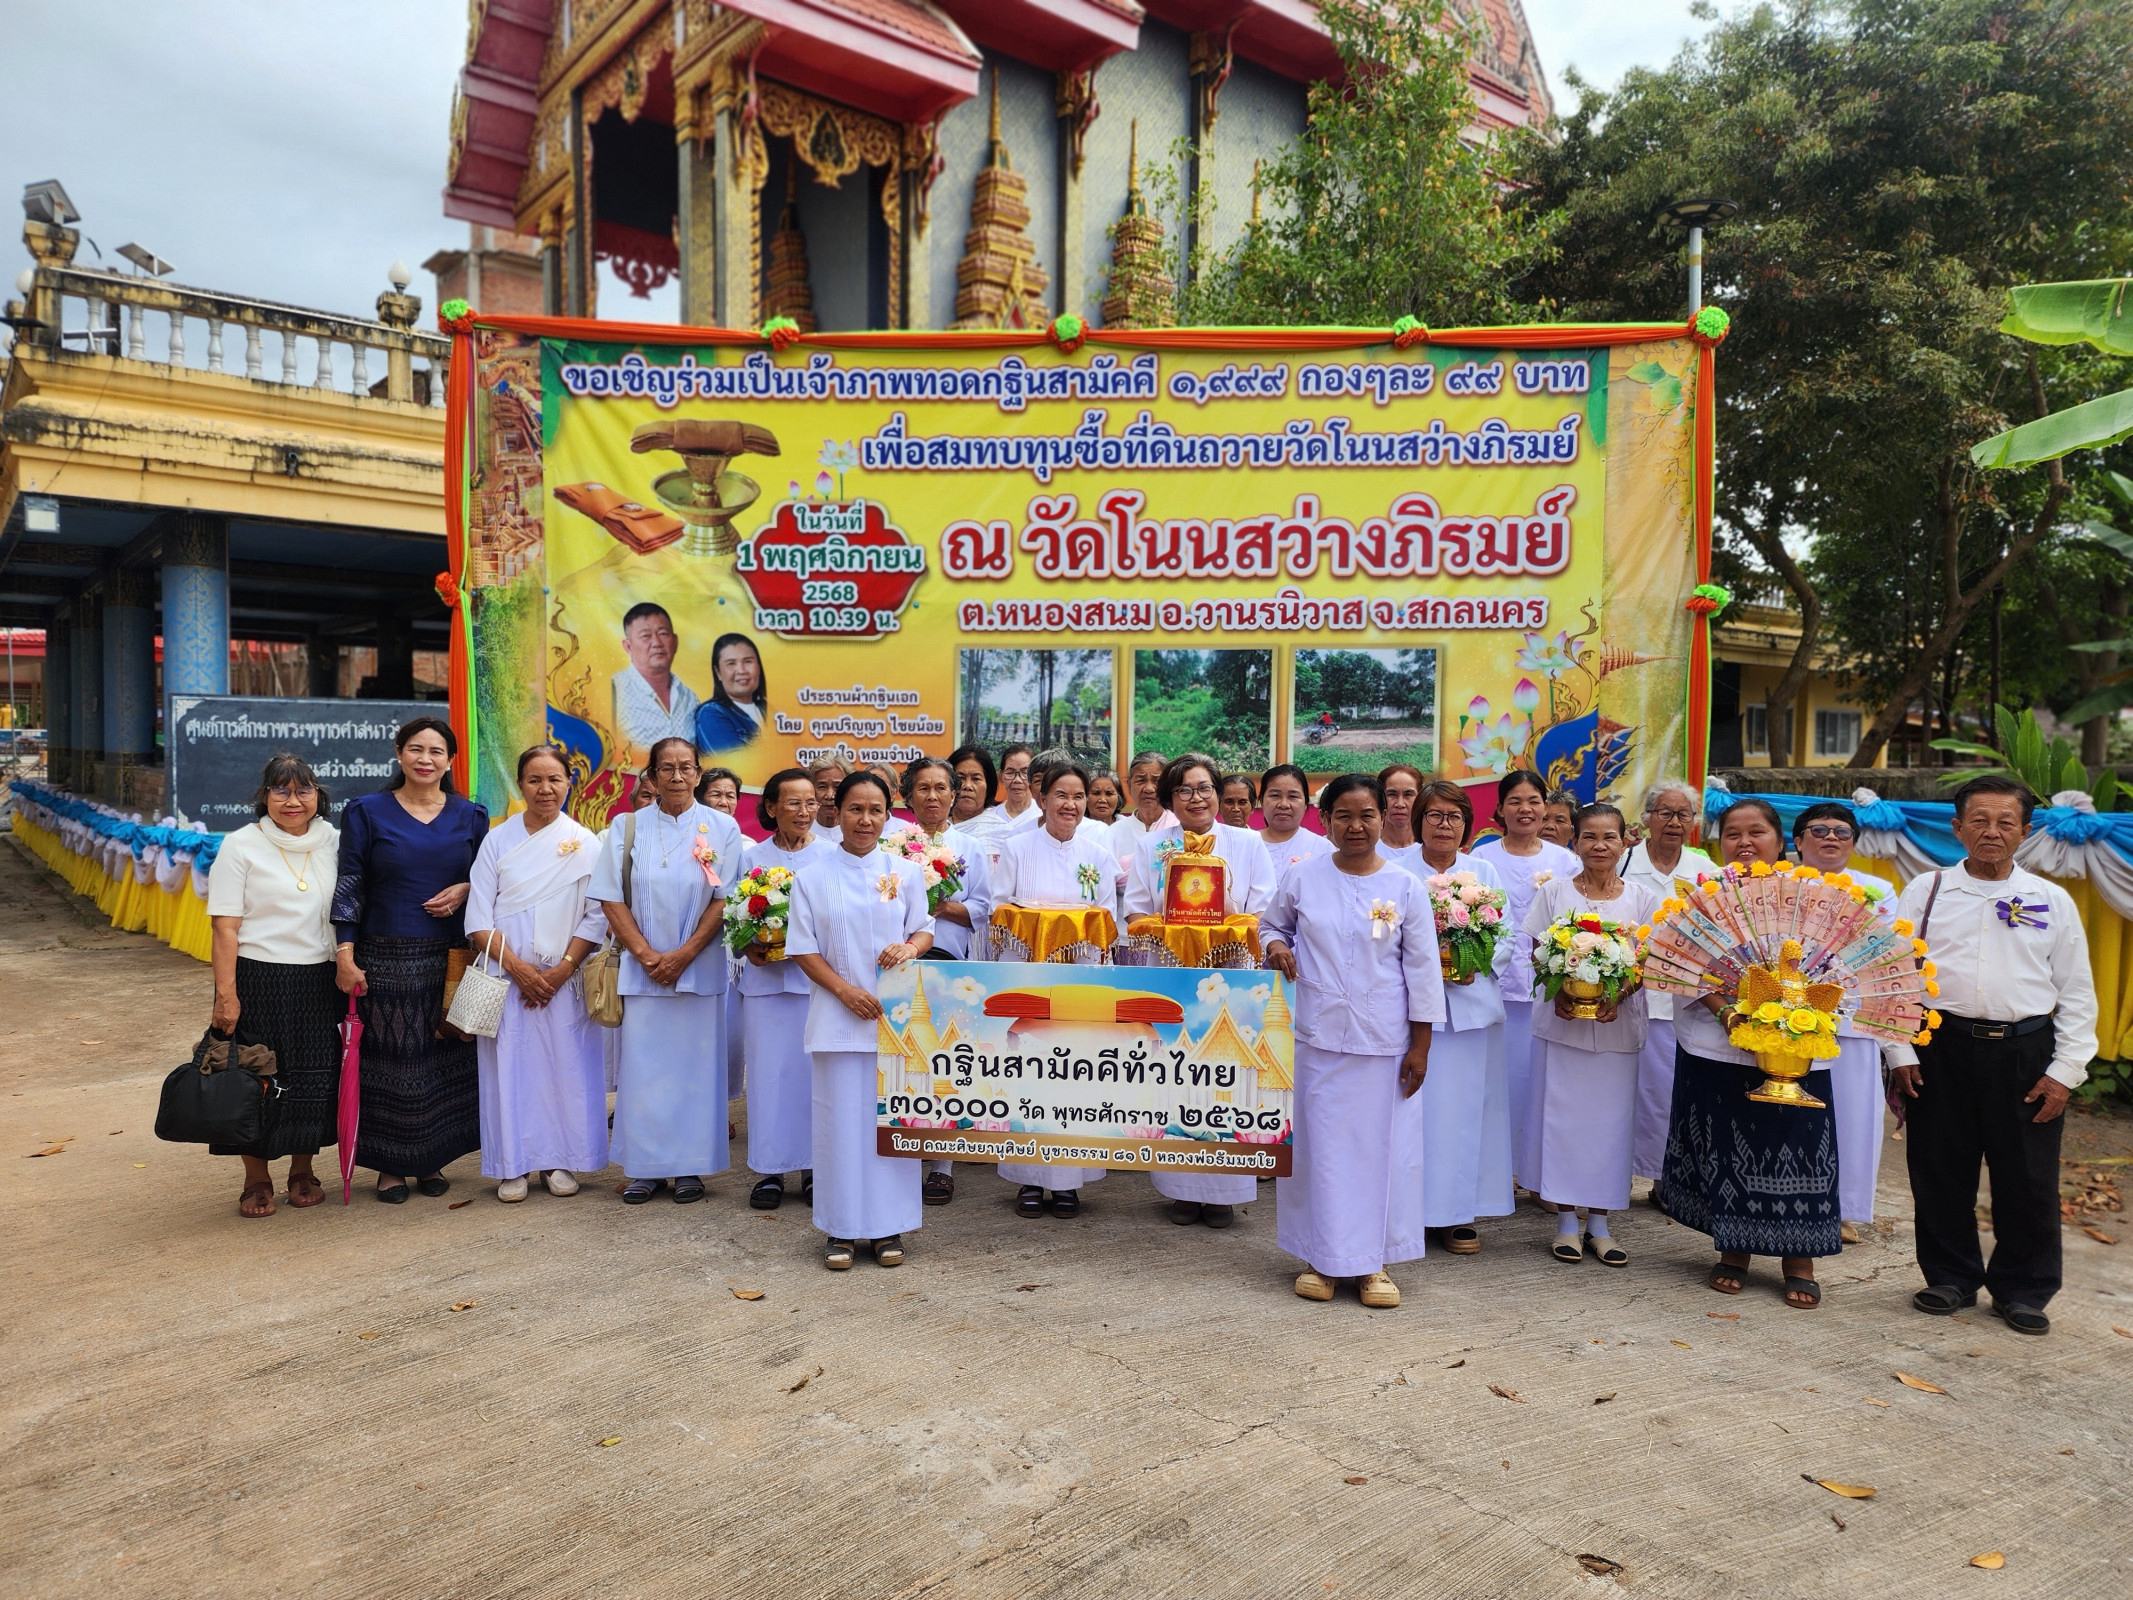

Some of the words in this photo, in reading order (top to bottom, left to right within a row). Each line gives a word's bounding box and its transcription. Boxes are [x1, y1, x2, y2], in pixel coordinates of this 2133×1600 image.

[565, 354, 1155, 406] ขอเชิญร่วมเป็นเจ้าภาพทอดกฐินสามัคคี
[1173, 365, 1285, 398] ๑,๙๙๙
[1302, 365, 1431, 402] กองๆละ
[1449, 364, 1501, 393] ๙๙
[1517, 362, 1586, 391] บาท
[865, 414, 1577, 478] เพื่อสมทบทุนซื้อที่ดินถวายวัดโนนสว่างภิรมย์
[796, 504, 863, 532] ในวันที่
[947, 526, 1005, 571] ณ
[1026, 490, 1570, 572] วัดโนนสว่างภิรมย์
[740, 544, 754, 568] 1
[766, 541, 921, 576] พฤศจิกายน
[805, 584, 855, 602] 2568
[758, 610, 801, 627] เวลา
[812, 610, 868, 627] 10.39
[876, 612, 899, 628] น.
[963, 602, 1151, 630] ต.หนองสนม
[799, 687, 918, 707] ประธานผ้ากฐินเอก
[186, 714, 401, 745] ศูนย์การศึกษาพระพุทธศาสนาวั
[776, 715, 802, 731] โดย
[811, 717, 884, 736] คุณปริญญา
[931, 1041, 1237, 1087] กฐินสามัคคีทั่วไทย
[889, 1093, 1010, 1121] ๓๐,๐๐๐
[1020, 1099, 1045, 1120] วัด
[1052, 1104, 1168, 1132] พุทธศักราช
[1179, 1103, 1282, 1132] ๒๕๖๘
[893, 1136, 920, 1151] โดย
[924, 1139, 1035, 1160] คณะศิษยานุศิษย์
[1040, 1145, 1109, 1162] บูชาธรรม
[1114, 1150, 1136, 1162] ๘๑
[1141, 1147, 1153, 1163] ปี
[1157, 1149, 1276, 1169] หลวงพ่อธัมมชโย
